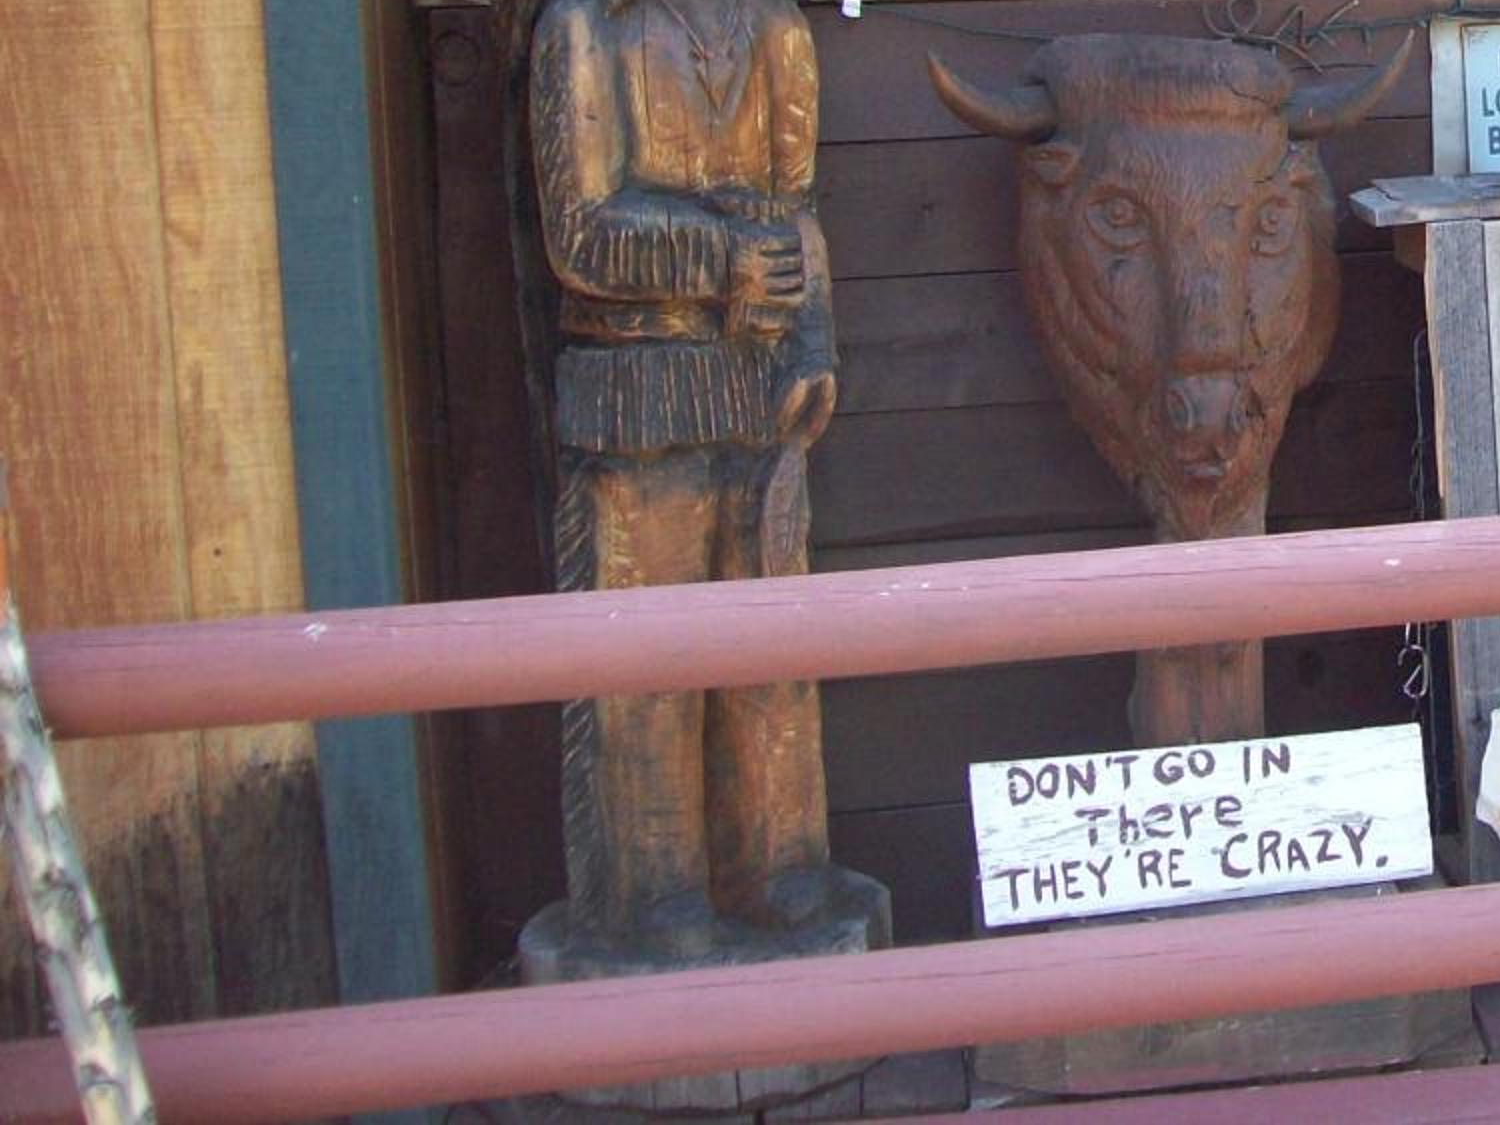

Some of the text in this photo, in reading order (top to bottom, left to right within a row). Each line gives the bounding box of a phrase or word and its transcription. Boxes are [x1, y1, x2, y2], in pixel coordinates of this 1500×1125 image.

[1007, 743, 1291, 806] DON'T GO IN
[1075, 794, 1243, 846] There
[992, 817, 1389, 910] THEY'RE CRAZY.
